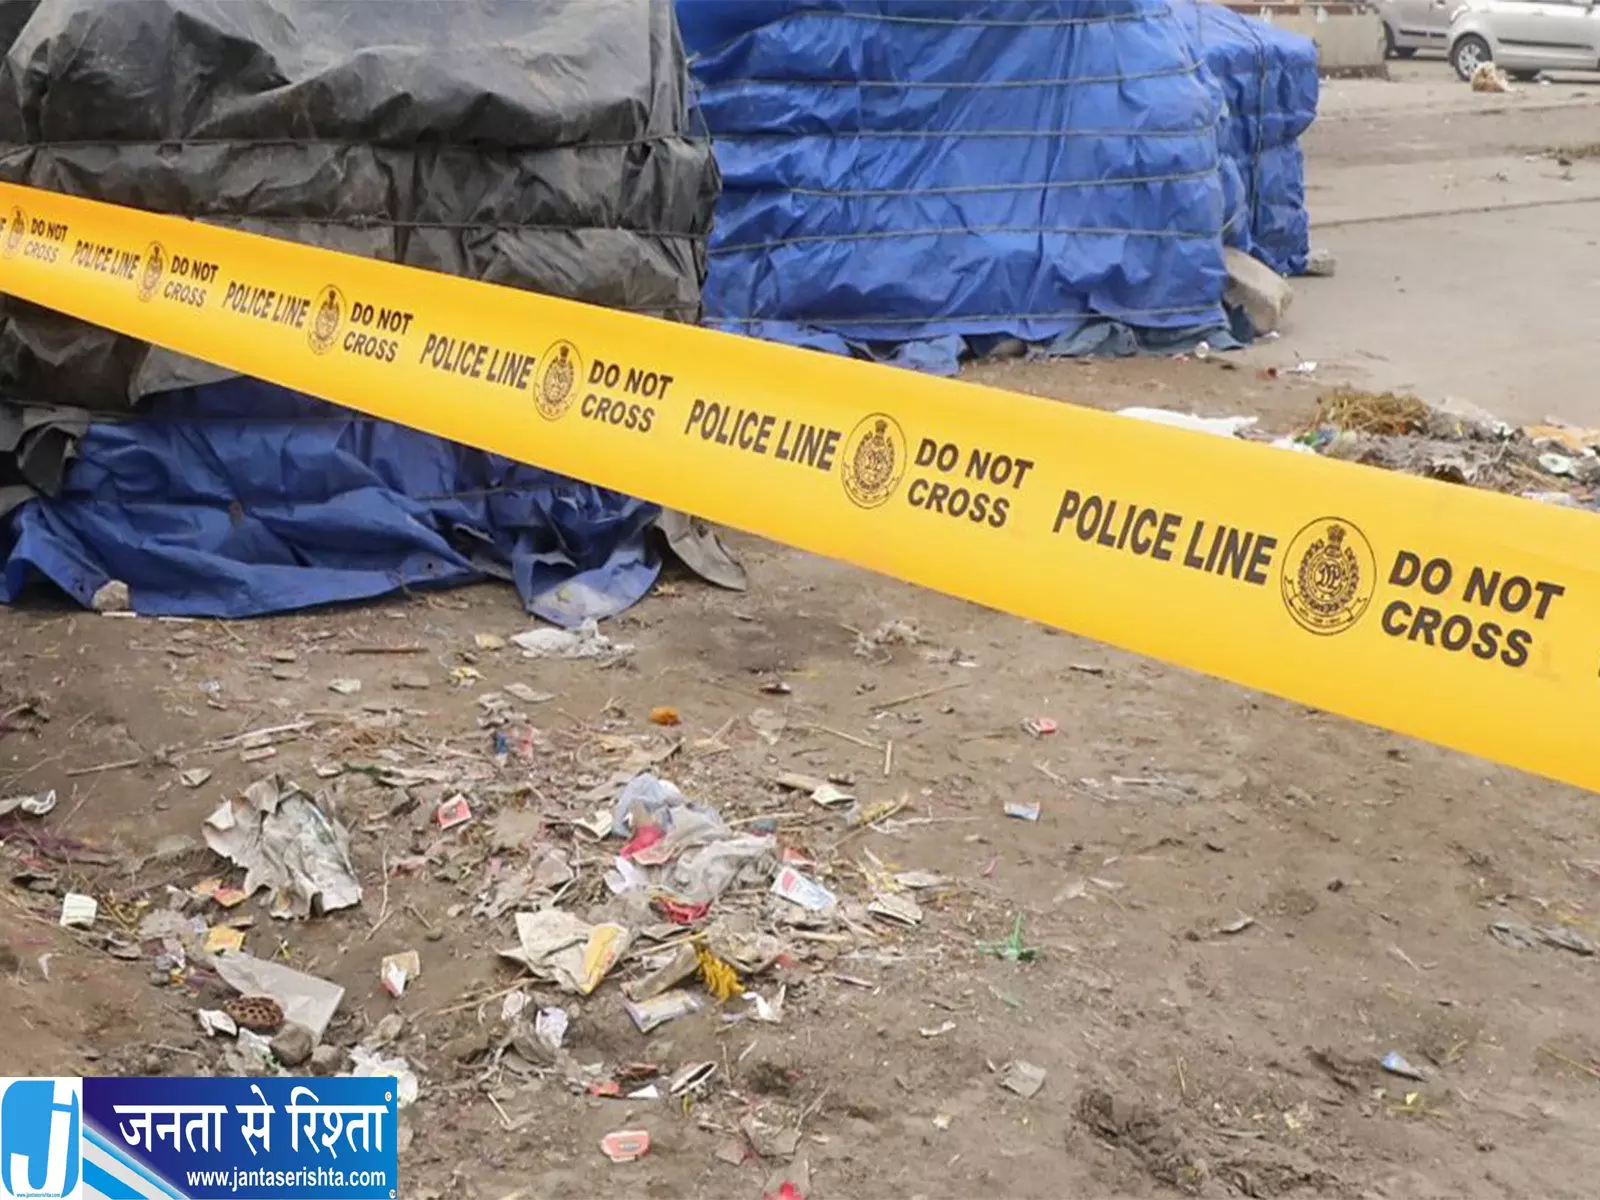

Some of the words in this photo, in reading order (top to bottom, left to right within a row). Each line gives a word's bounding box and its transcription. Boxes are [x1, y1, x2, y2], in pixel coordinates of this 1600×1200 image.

[30, 217, 46, 237] DO
[46, 221, 68, 241] NOT
[24, 240, 59, 263] CROSS
[71, 239, 113, 272] POLICE
[110, 249, 141, 280] LINE
[171, 255, 189, 276] DO
[190, 260, 219, 284] NOT
[163, 284, 207, 308] CROSS
[222, 281, 276, 320] POLICE
[273, 294, 311, 328] LINE
[351, 302, 374, 327] DO
[376, 308, 414, 335] NOT
[343, 331, 399, 363] CROSS
[419, 333, 489, 377] POLICE
[485, 350, 535, 390] LINE
[587, 359, 621, 388] DO
[625, 368, 674, 400] NOT
[580, 394, 655, 433] CROSS
[684, 399, 776, 454] POLICE
[774, 421, 842, 472] LINE
[915, 438, 961, 474] DO
[965, 450, 1034, 490] NOT
[907, 479, 1010, 528] CROSS
[1053, 489, 1182, 561] POLICE
[1183, 520, 1278, 586] LINE
[1388, 550, 1452, 595] DO
[1463, 566, 1565, 621] NOT
[1381, 600, 1533, 668] CROSS
